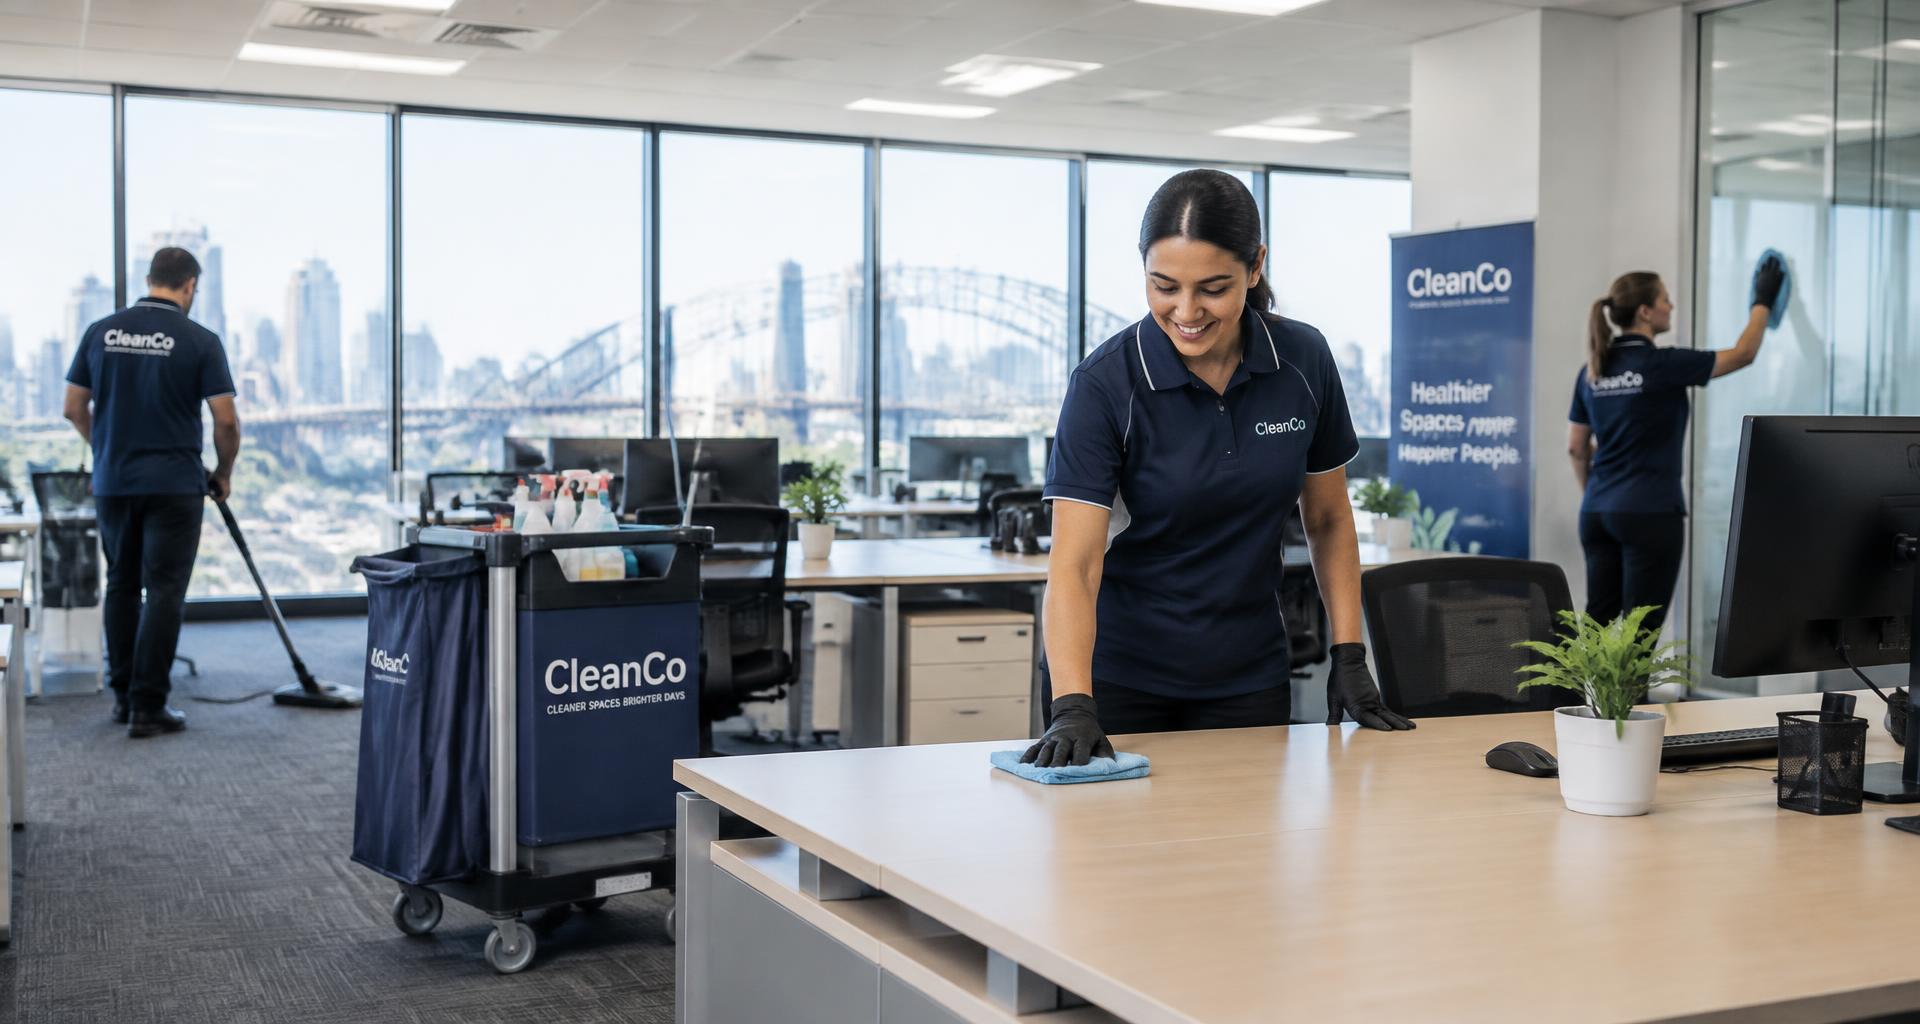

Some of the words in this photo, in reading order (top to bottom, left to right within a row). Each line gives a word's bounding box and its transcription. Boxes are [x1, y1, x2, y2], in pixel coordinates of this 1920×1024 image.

[1407, 262, 1512, 299] CleanCo
[104, 328, 175, 350] CleanCo
[1411, 379, 1493, 405] Healthier
[1255, 417, 1306, 436] CleanCo
[544, 651, 687, 695] CleanCo
[547, 702, 586, 715] CLEANER
[588, 698, 621, 711] SPACES
[623, 693, 662, 707] BRIGHTER
[664, 691, 686, 702] DAYS
